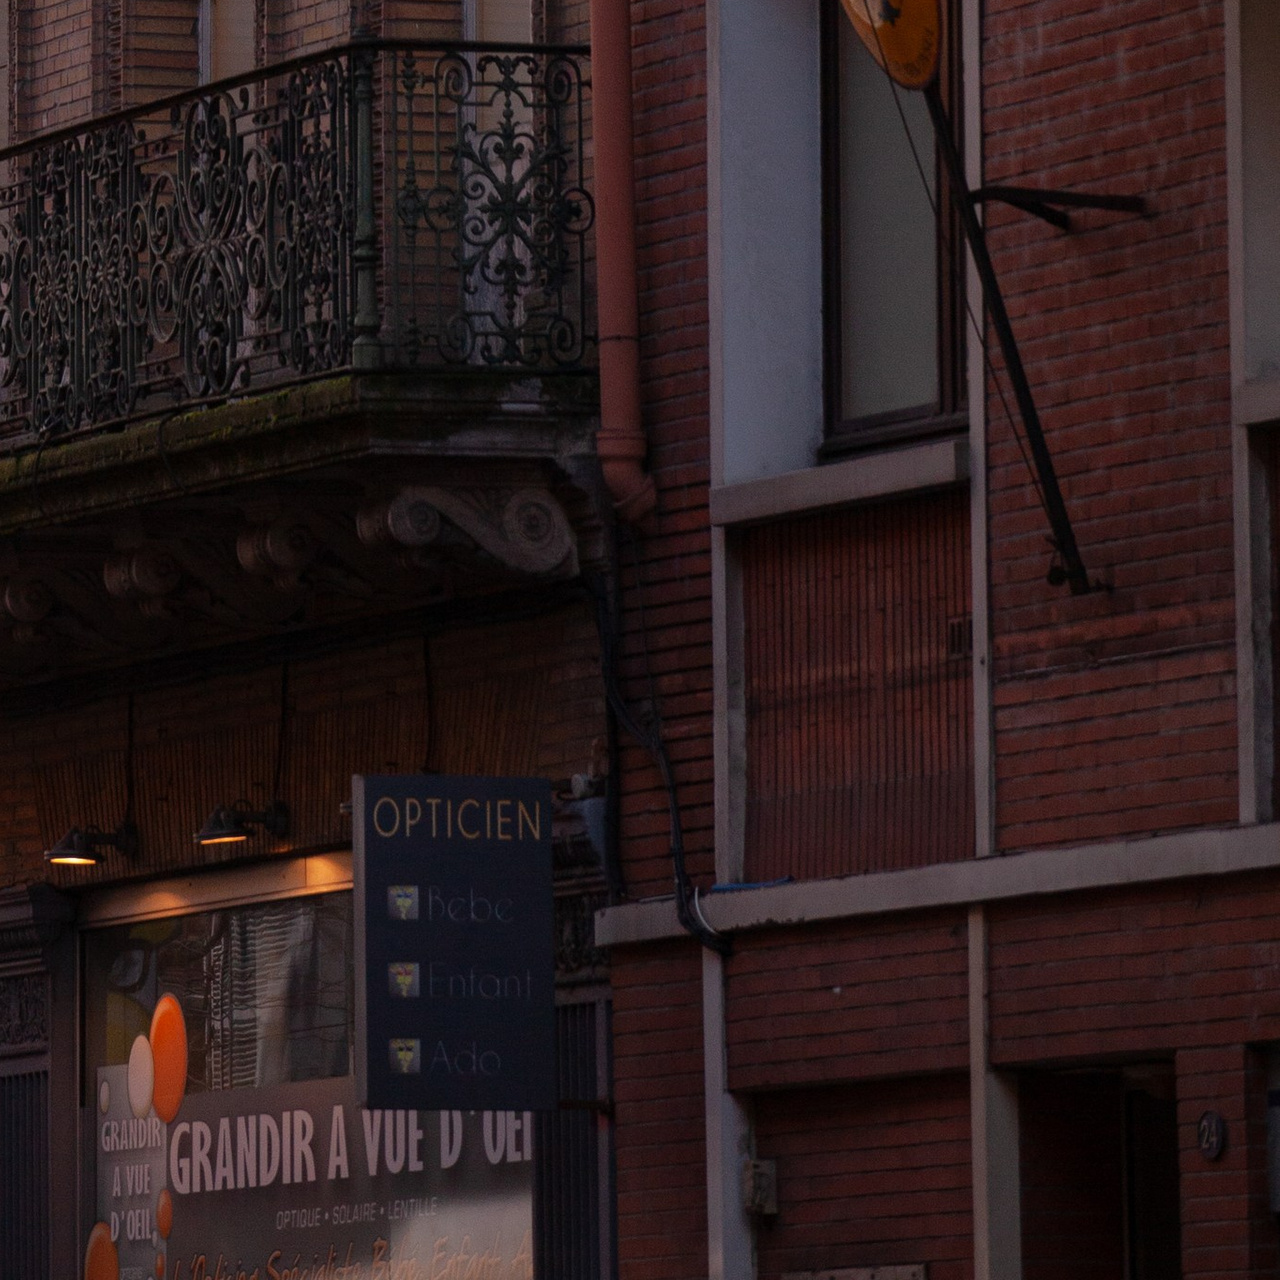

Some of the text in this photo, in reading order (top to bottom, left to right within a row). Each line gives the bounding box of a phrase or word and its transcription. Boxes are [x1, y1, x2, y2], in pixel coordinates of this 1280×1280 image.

[373, 796, 541, 840] OPTICIEN
[428, 961, 533, 1000] Enfant
[429, 1040, 502, 1076] Ado
[101, 1117, 162, 1152] GRANDIR
[169, 1109, 317, 1195] GRANDIR
[326, 1104, 350, 1180] A
[361, 1108, 424, 1177] VUE
[112, 1163, 150, 1197] A VUE
[276, 1196, 438, 1230] OPTIQUE SOLAIRE LENTILLE
